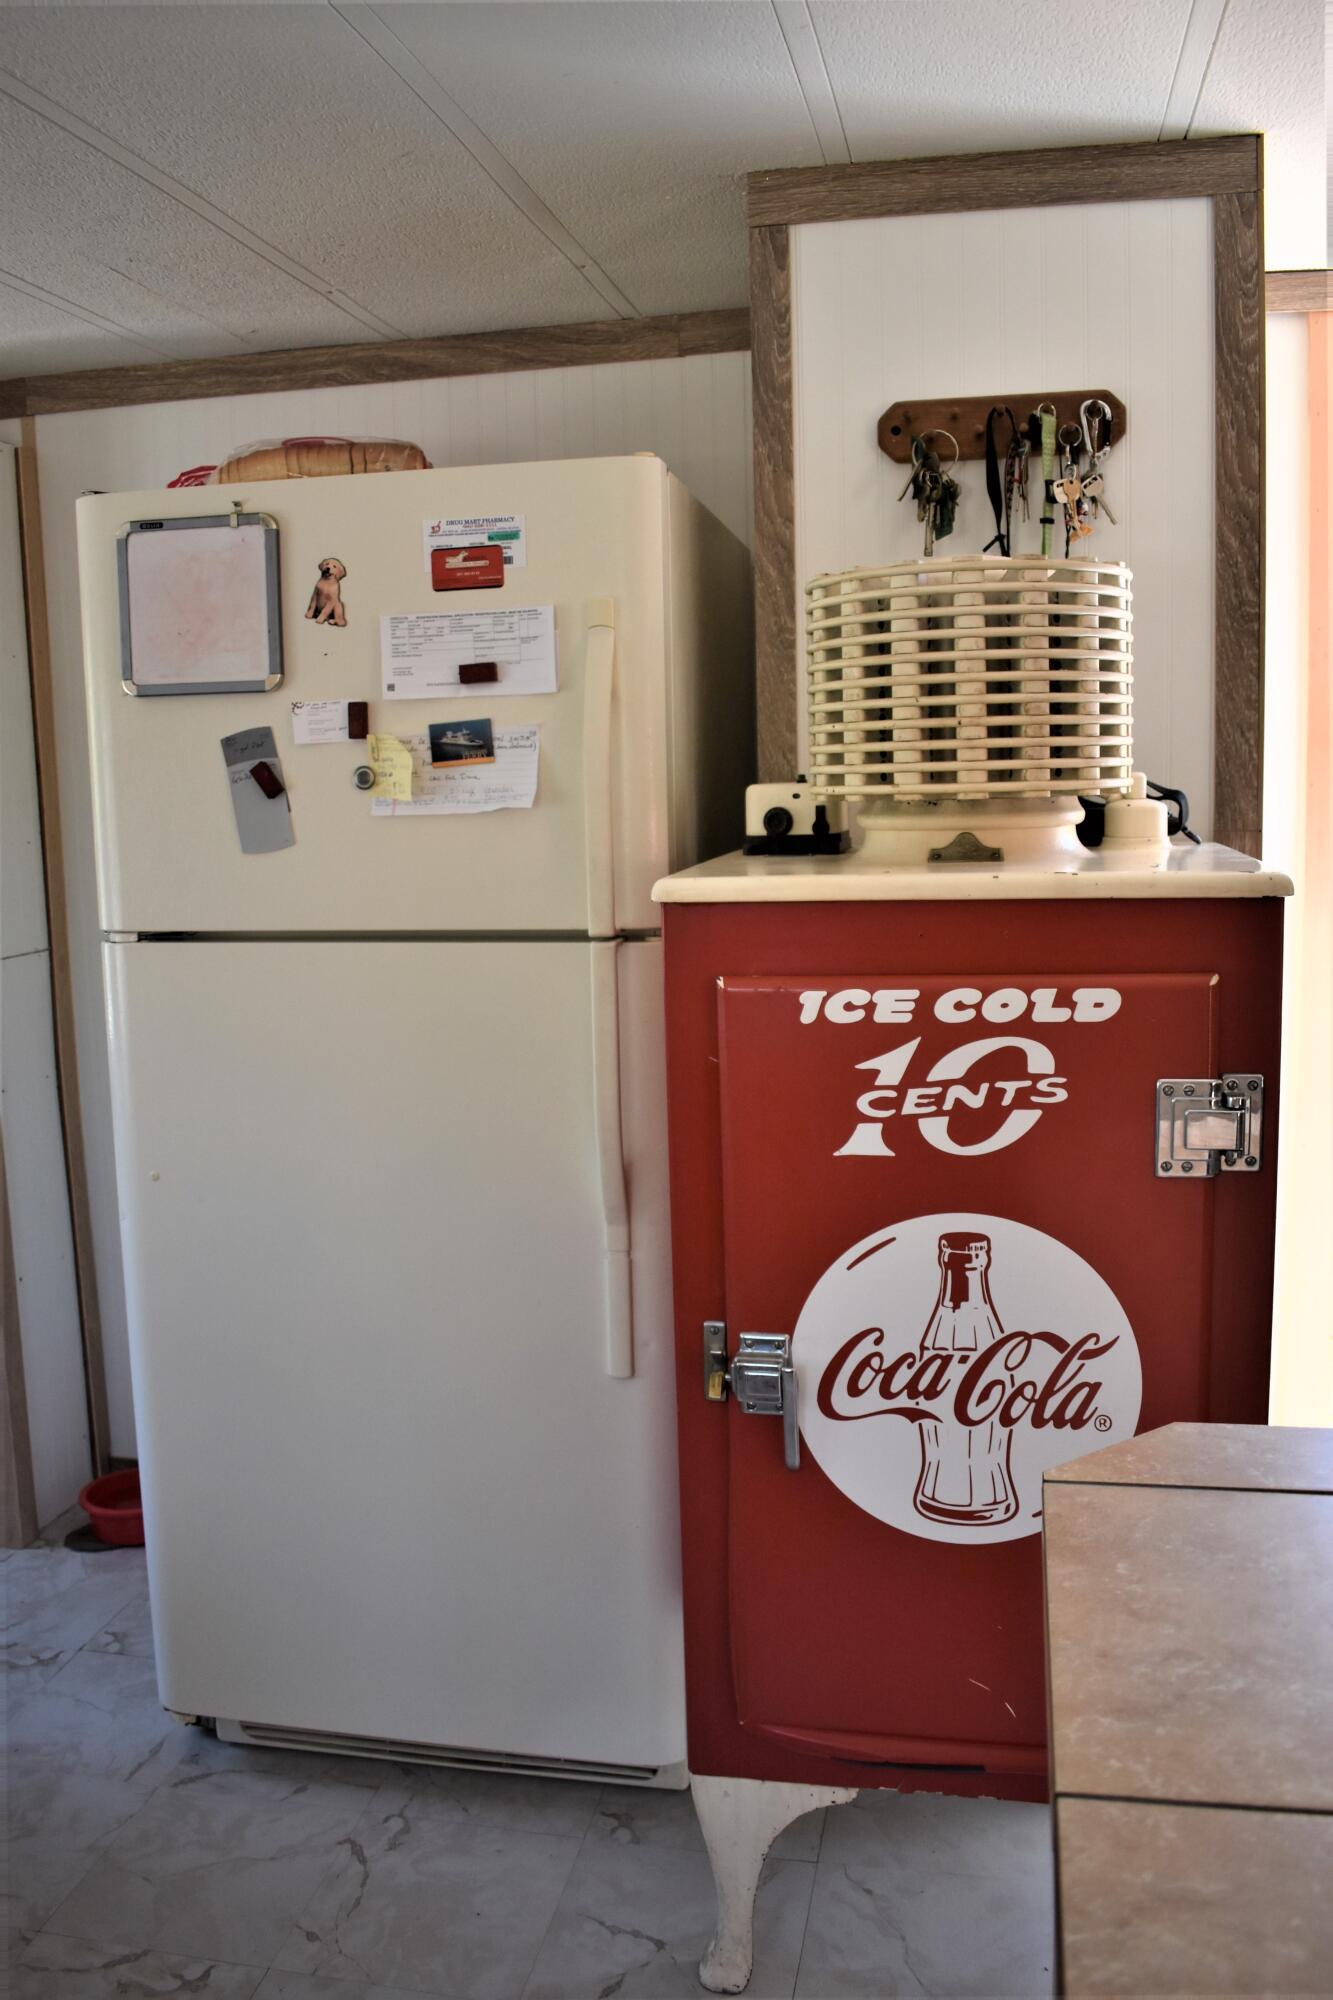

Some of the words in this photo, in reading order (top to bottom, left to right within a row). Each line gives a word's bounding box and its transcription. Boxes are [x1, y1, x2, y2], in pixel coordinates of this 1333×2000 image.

[799, 988, 921, 1024] ICE
[933, 987, 1123, 1024] COLD
[832, 1036, 1056, 1157] 10
[856, 1076, 1069, 1118] CENTS
